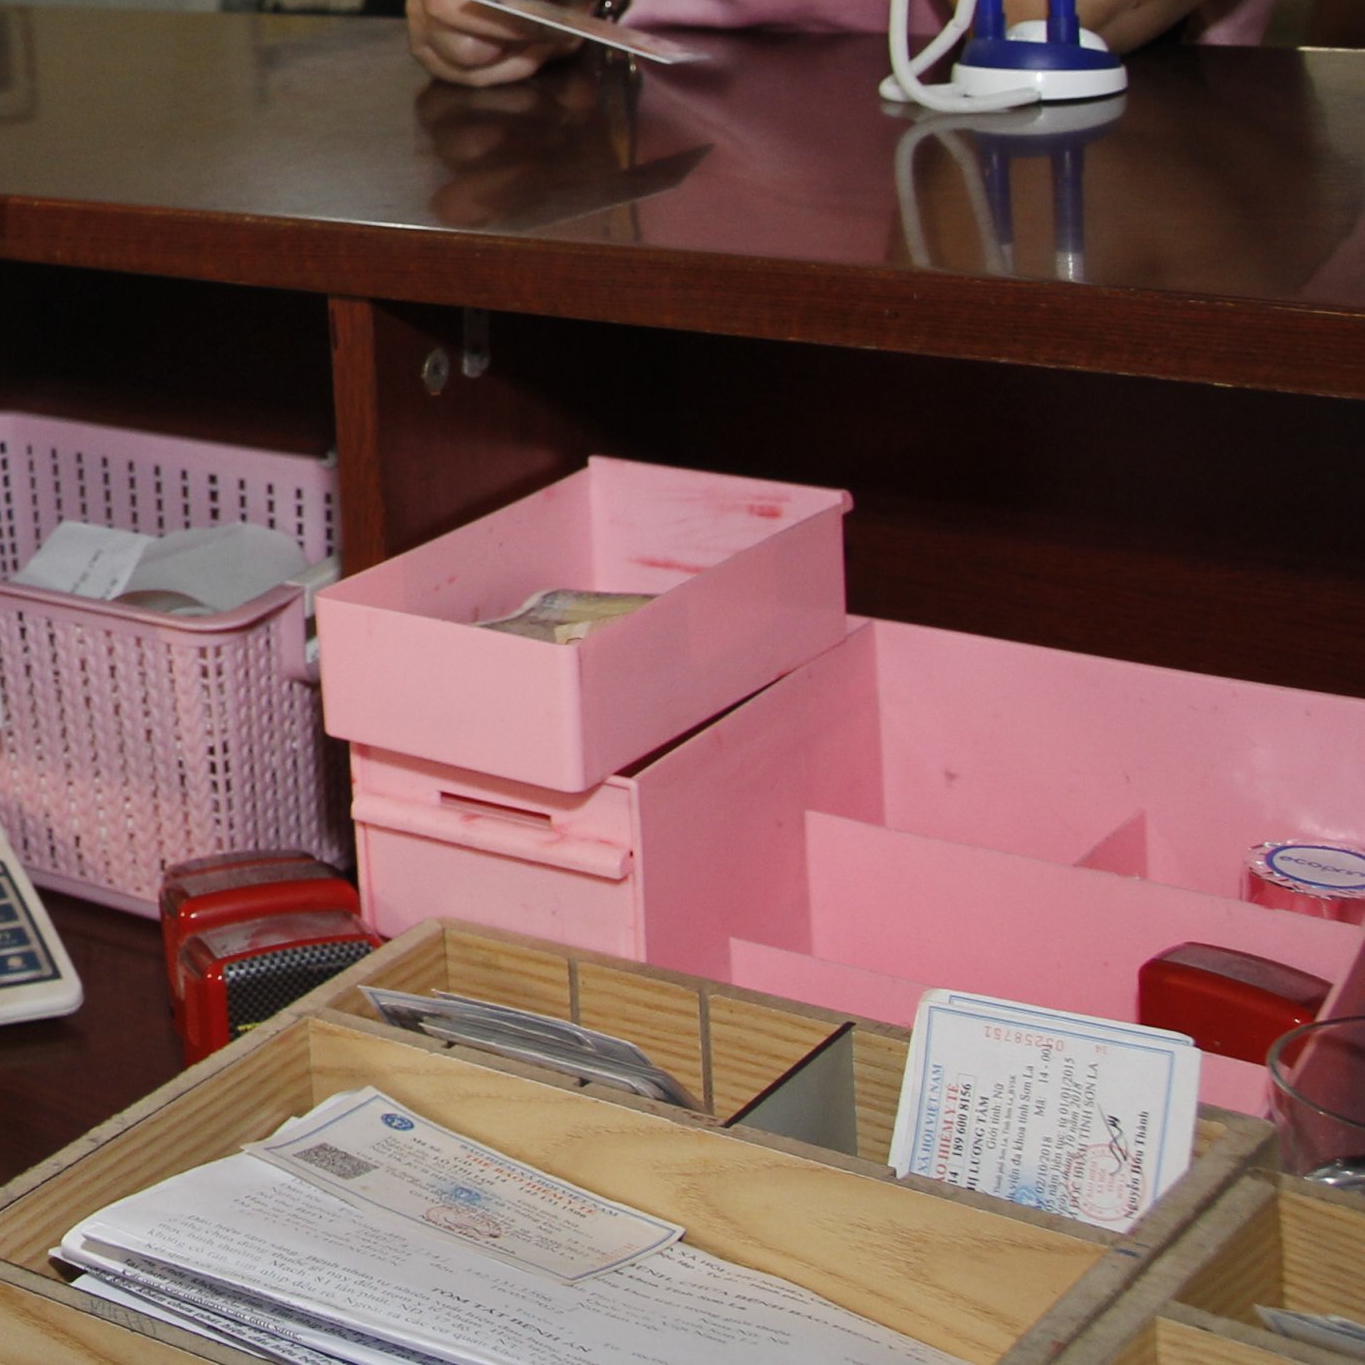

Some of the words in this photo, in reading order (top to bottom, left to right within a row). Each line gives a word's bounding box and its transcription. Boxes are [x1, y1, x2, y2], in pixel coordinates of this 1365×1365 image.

[1279, 854, 1365, 878] ecoprin
[928, 1063, 942, 1092] NAM
[1021, 1064, 1034, 1078] La
[943, 1082, 959, 1103] TẾ
[957, 1082, 972, 1111] 8156
[1018, 1080, 1032, 1101] Sơn
[923, 1095, 940, 1126] VIỆT
[943, 1105, 956, 1115] Y
[972, 1094, 989, 1124] TÂM
[1015, 1104, 1029, 1124] tỉnh
[954, 1112, 968, 1135] 600
[920, 1128, 934, 1152] HỘI
[951, 1137, 965, 1157] 189
[1012, 1125, 1026, 1151] khoa
[967, 1126, 985, 1174] LƯƠNG
[1010, 1153, 1022, 1166] đa
[916, 1155, 929, 1172] XÃ
[1034, 1135, 1052, 1194] 02/10/2018
[1008, 1167, 1021, 1190] viện
